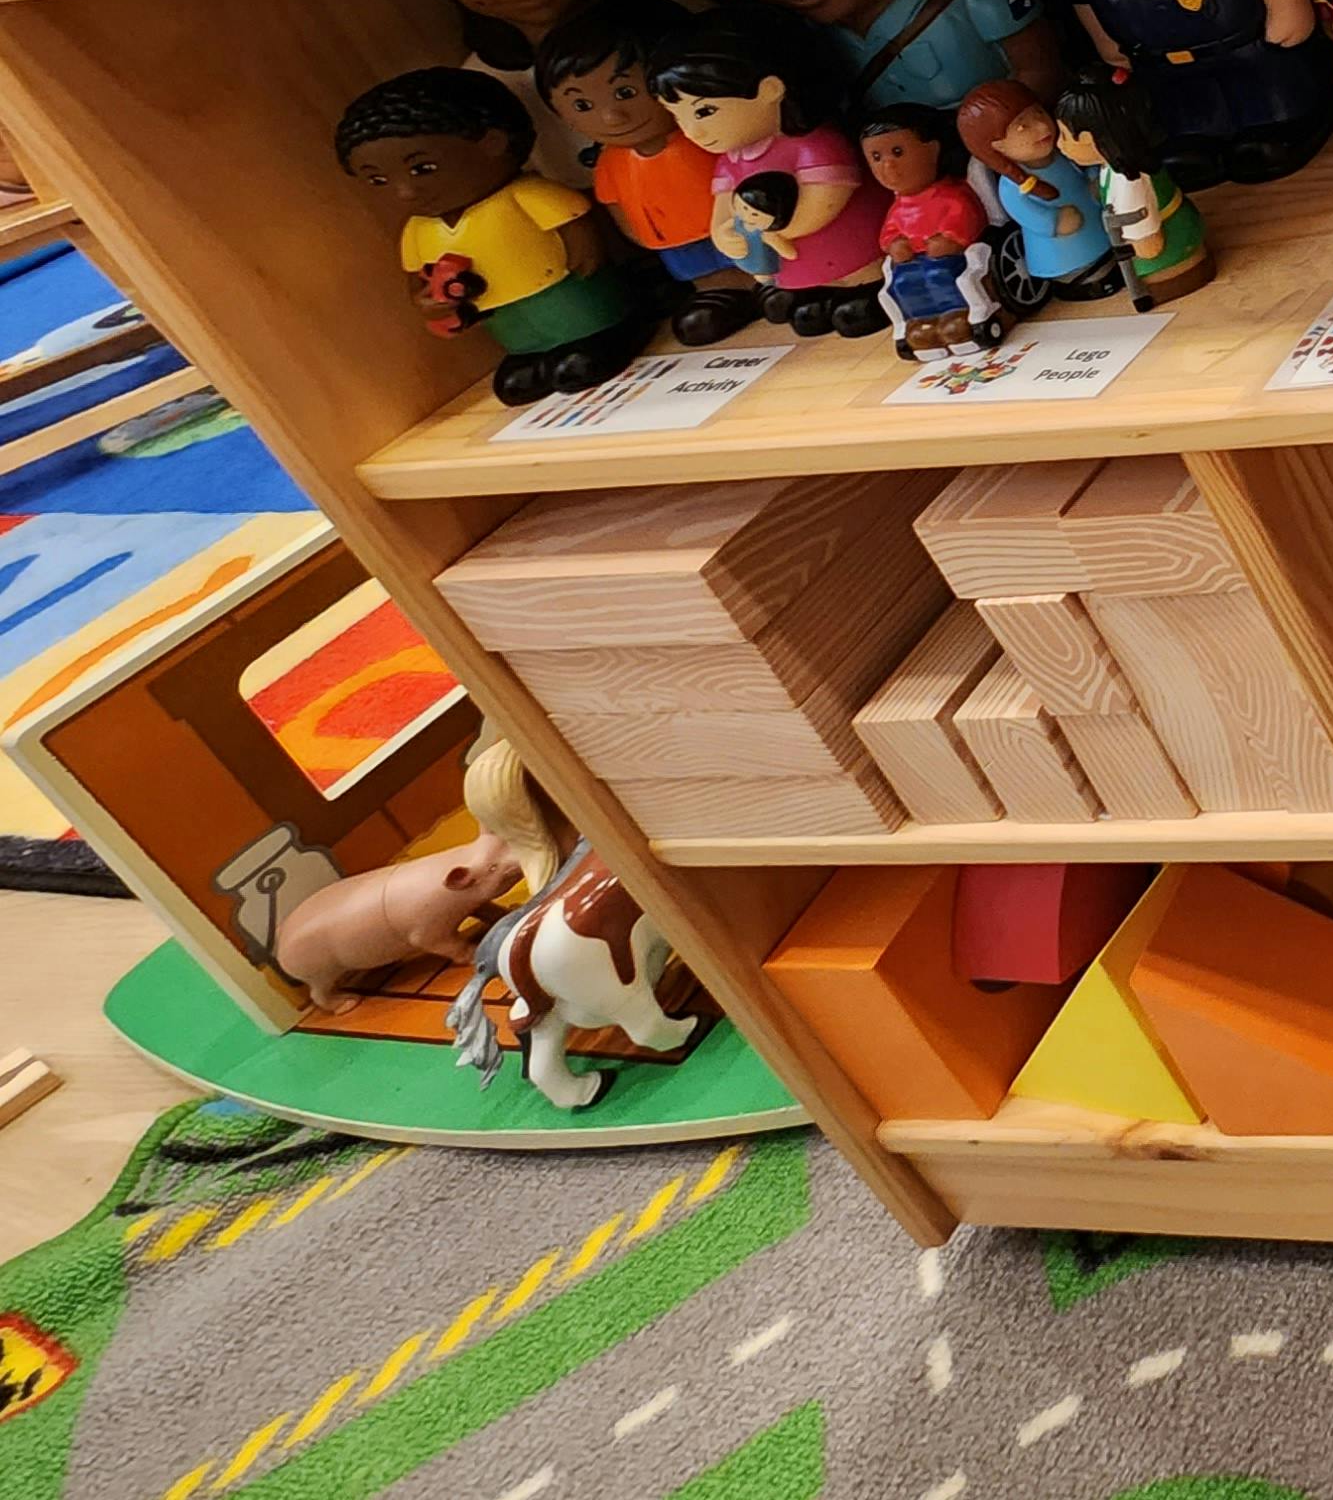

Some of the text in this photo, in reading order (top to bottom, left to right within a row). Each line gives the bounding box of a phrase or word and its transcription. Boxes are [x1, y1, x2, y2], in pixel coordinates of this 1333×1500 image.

[704, 356, 769, 369] Career
[1065, 346, 1110, 365] Lego
[1033, 366, 1100, 383] People
[667, 378, 745, 394] Activity
